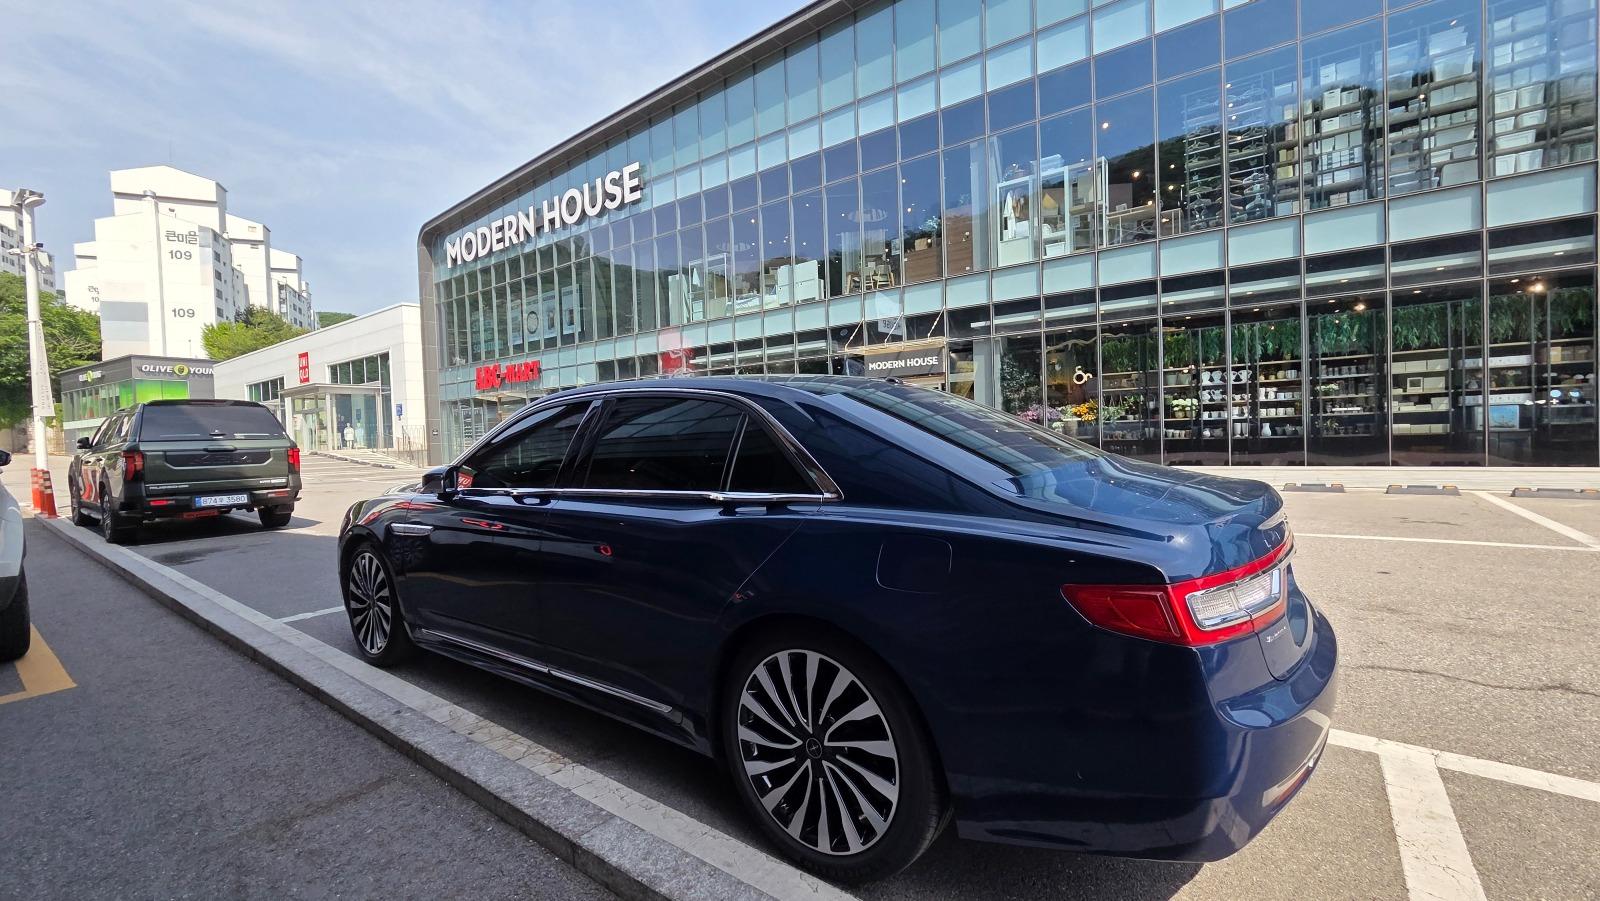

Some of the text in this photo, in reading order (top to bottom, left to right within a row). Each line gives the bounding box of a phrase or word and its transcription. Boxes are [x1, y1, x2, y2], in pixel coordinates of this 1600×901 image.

[446, 162, 642, 269] MODERN HOUSE
[165, 230, 199, 245] 큰마을
[168, 250, 192, 260] 109
[172, 308, 195, 318] 109
[141, 364, 173, 374] OLIVE
[868, 356, 939, 371] MODERN HOUSE
[475, 360, 541, 390] ABC-MART
